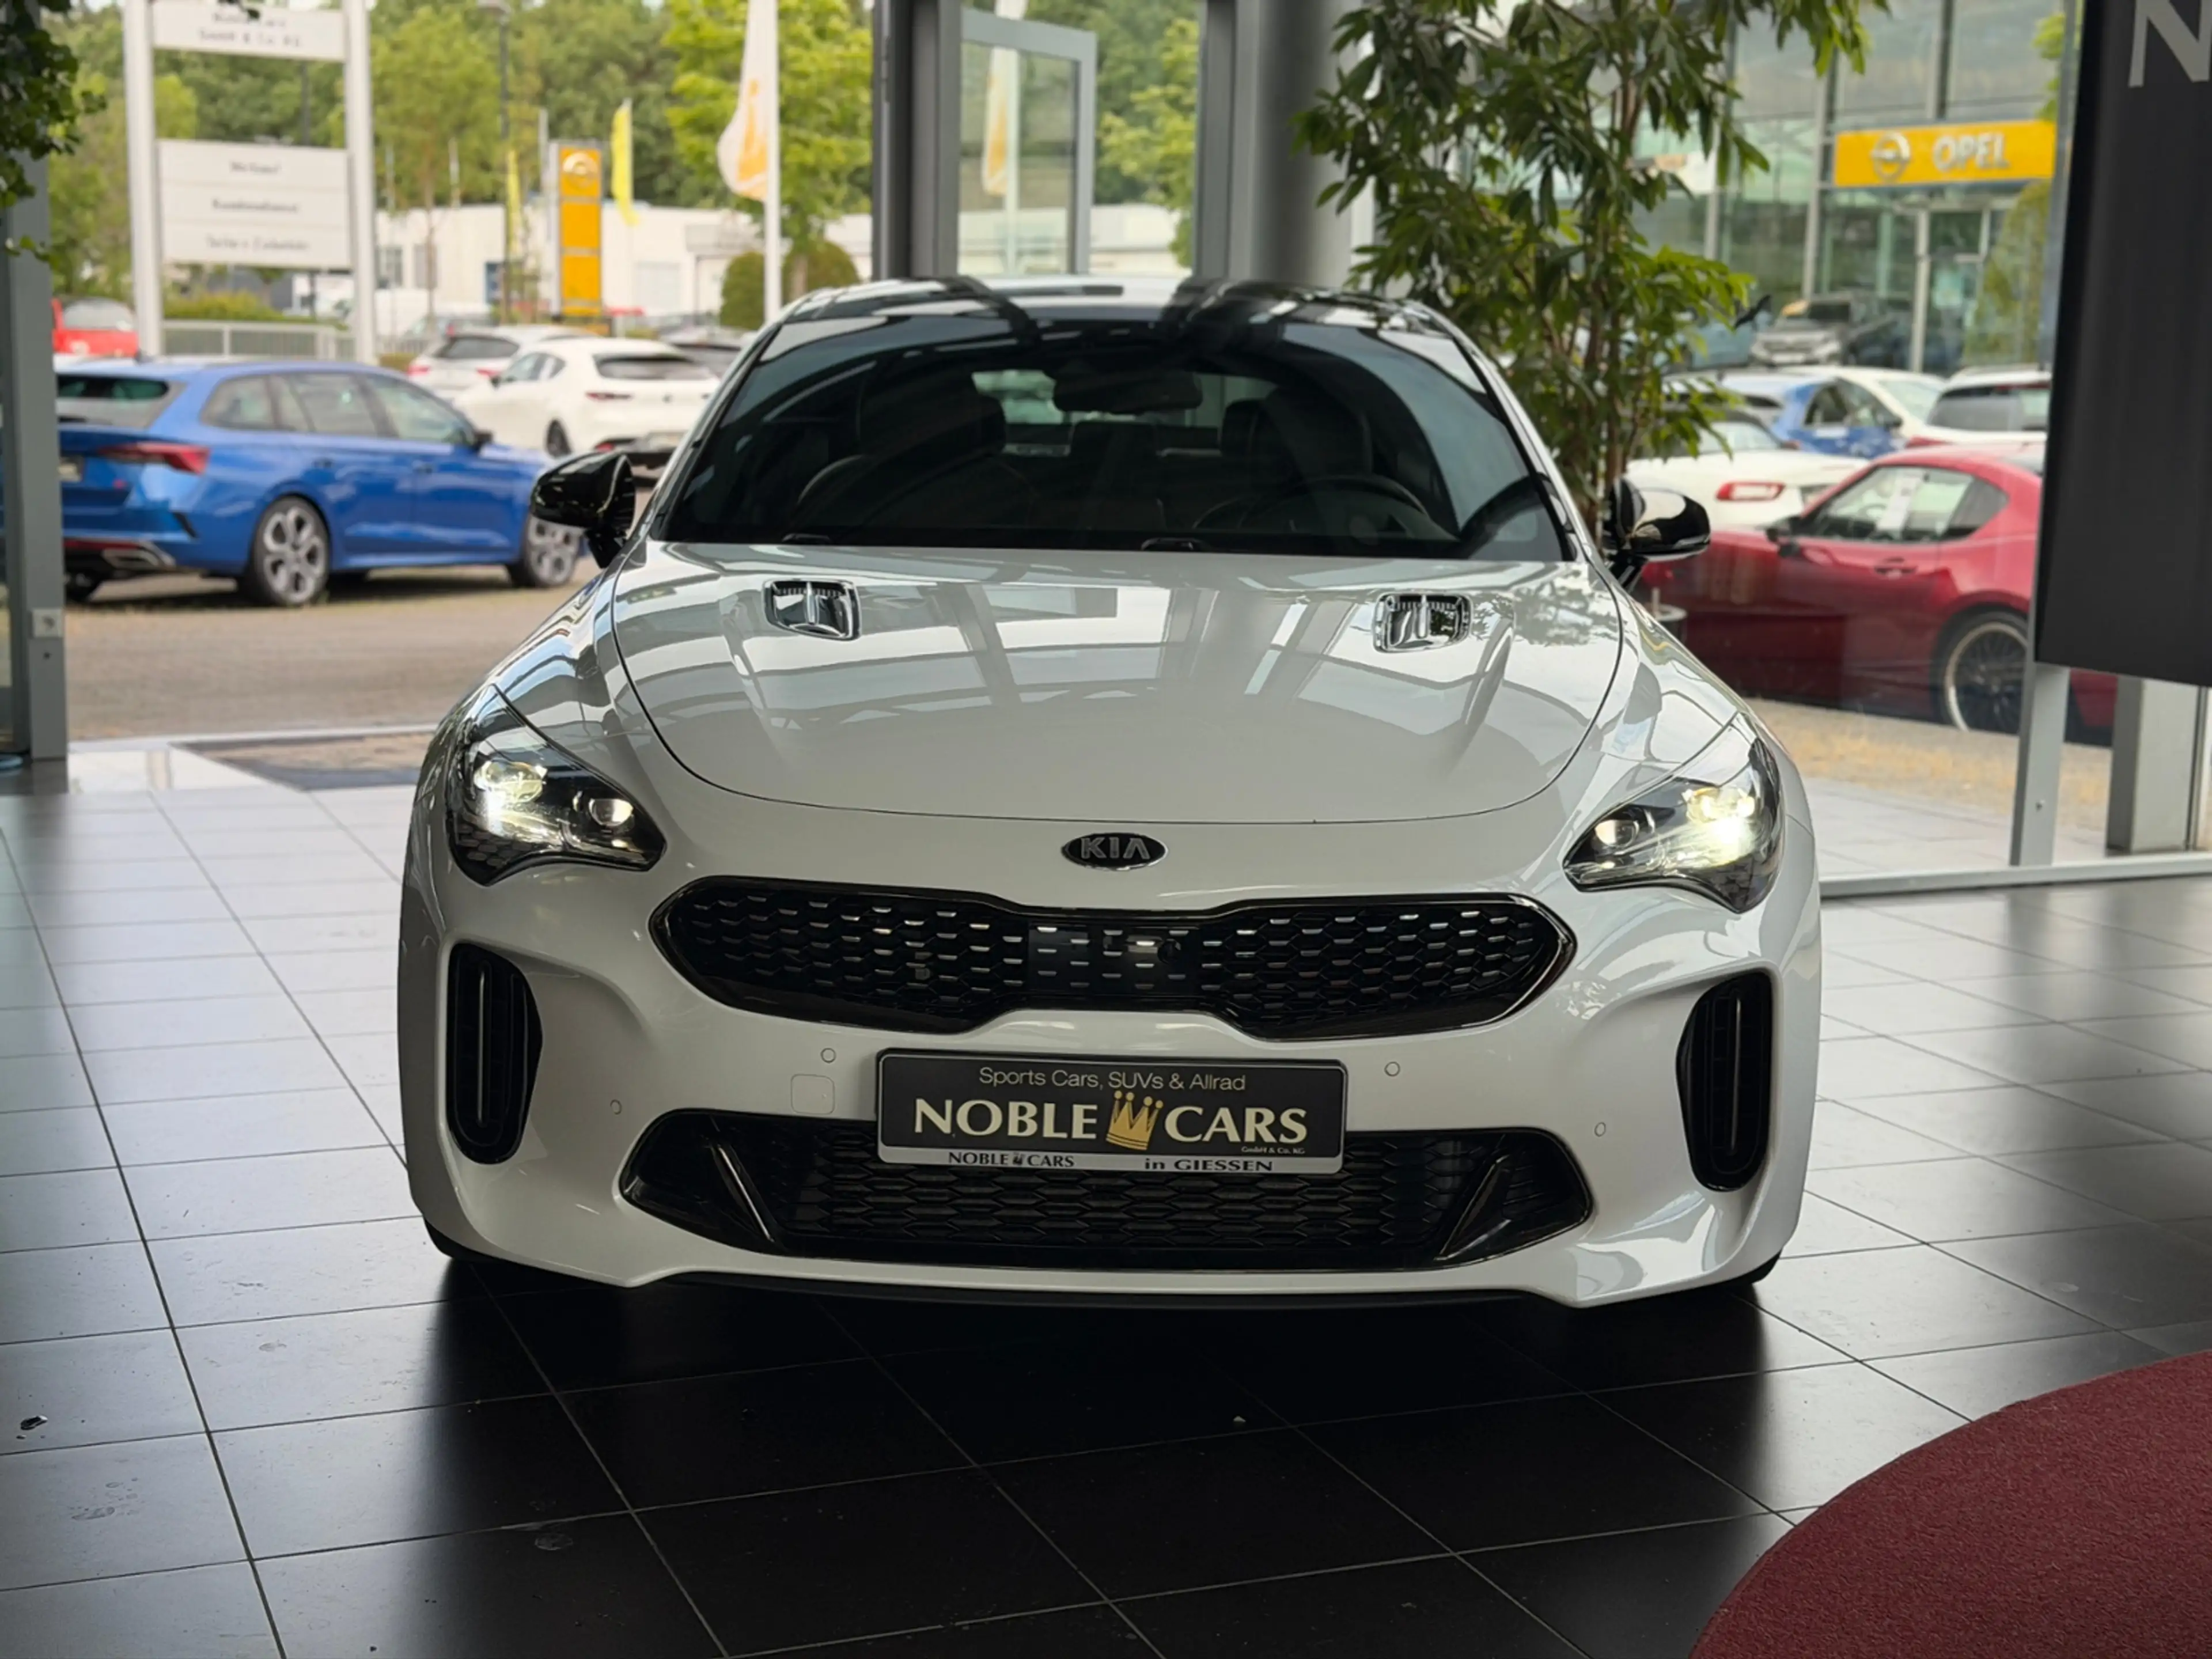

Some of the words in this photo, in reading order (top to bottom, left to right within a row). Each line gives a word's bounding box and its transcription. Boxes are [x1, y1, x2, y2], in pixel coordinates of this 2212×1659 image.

[1932, 132, 2012, 173] OPEL
[1081, 837, 1151, 859] KIA
[979, 1067, 1046, 1087] Sports
[1051, 1069, 1104, 1090] Cars,
[1108, 1071, 1164, 1089] SUVs
[1168, 1073, 1184, 1090] &
[1189, 1073, 1245, 1091] Allrad
[914, 1098, 1098, 1139] NOBLE
[1164, 1105, 1308, 1144] CARS
[949, 1152, 1009, 1166] NOBLE
[1027, 1154, 1074, 1168] CARS
[1144, 1158, 1165, 1170] in
[1173, 1158, 1273, 1172] GIESSEN
